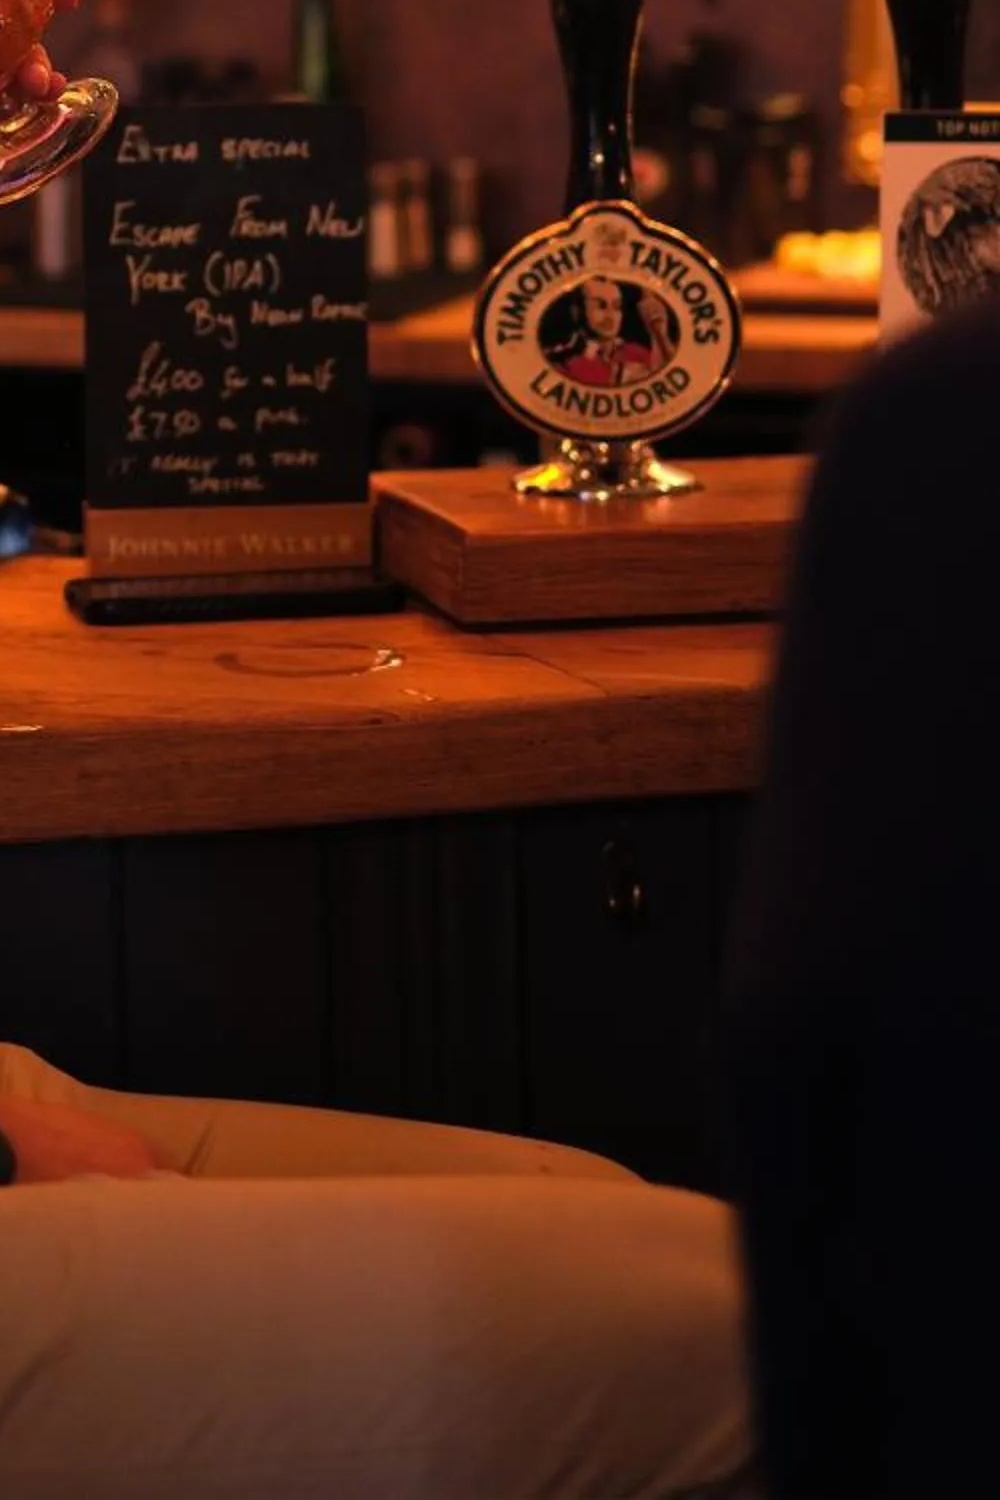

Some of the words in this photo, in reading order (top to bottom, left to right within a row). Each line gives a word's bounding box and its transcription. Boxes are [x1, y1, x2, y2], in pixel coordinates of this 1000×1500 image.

[203, 250, 282, 298] (IPA)
[496, 241, 587, 346] TIMOTHY
[629, 241, 721, 345] TAYLOR'S
[529, 366, 691, 419] LANDLORD
[240, 533, 355, 557] WALKER
